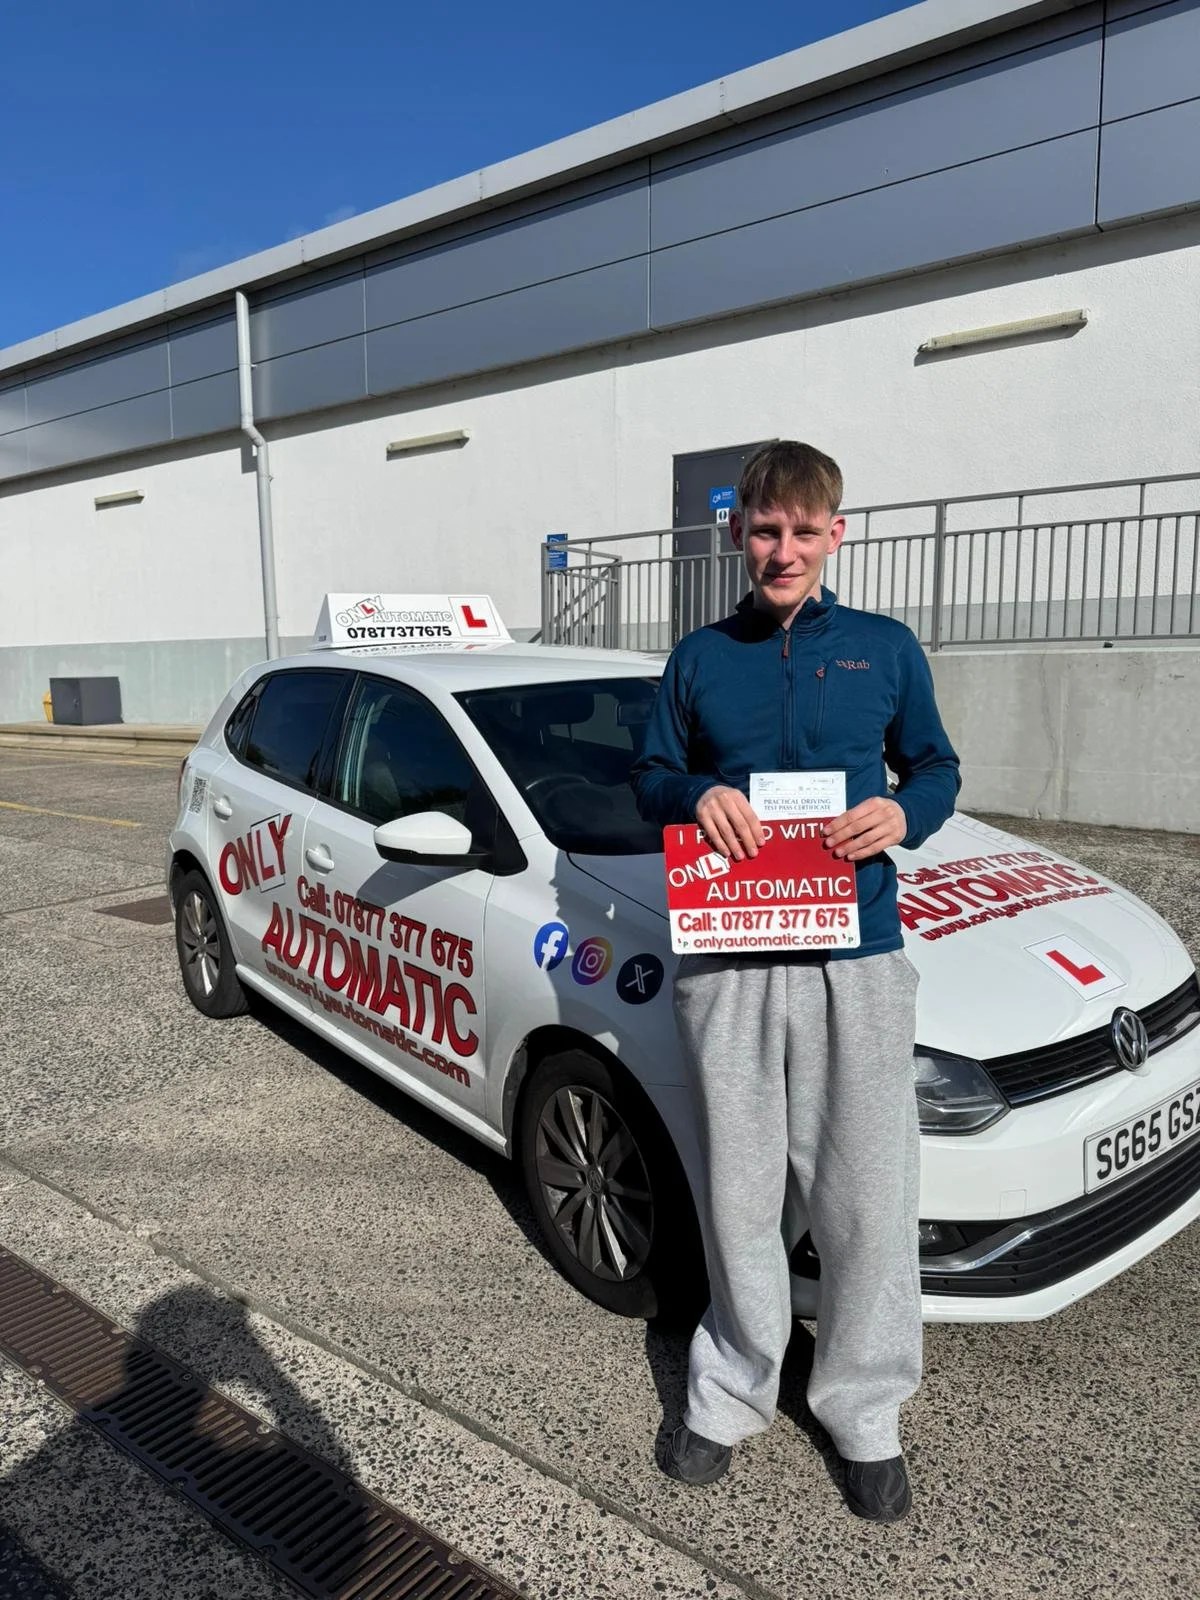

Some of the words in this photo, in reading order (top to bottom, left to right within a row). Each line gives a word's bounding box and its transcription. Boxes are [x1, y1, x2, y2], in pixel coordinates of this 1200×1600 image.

[336, 595, 384, 627] ONLY
[373, 611, 453, 623] AUTOMATIC
[461, 605, 487, 628] L
[347, 625, 452, 639] 07877377675
[847, 659, 870, 670] Rab
[679, 829, 684, 845] I
[780, 822, 824, 839] WIT
[219, 813, 292, 896] ONLY
[938, 856, 997, 876] 07877
[706, 876, 852, 902] AUTOMATIC
[896, 863, 1100, 931] AUTOMATIC
[297, 875, 331, 918] Call:
[334, 890, 386, 941] 07877
[390, 912, 427, 958] 377
[431, 928, 474, 978] 675
[678, 912, 717, 934] Call:
[721, 910, 774, 931] 07877
[779, 909, 810, 930] 377
[815, 907, 850, 928] 675
[693, 933, 838, 950] onlyautomatic.com
[261, 901, 479, 1057] AUTOMATIC
[1046, 950, 1106, 986] L
[264, 959, 472, 1088] www.onlyautomatic.com
[1096, 1110, 1161, 1180] SG65
